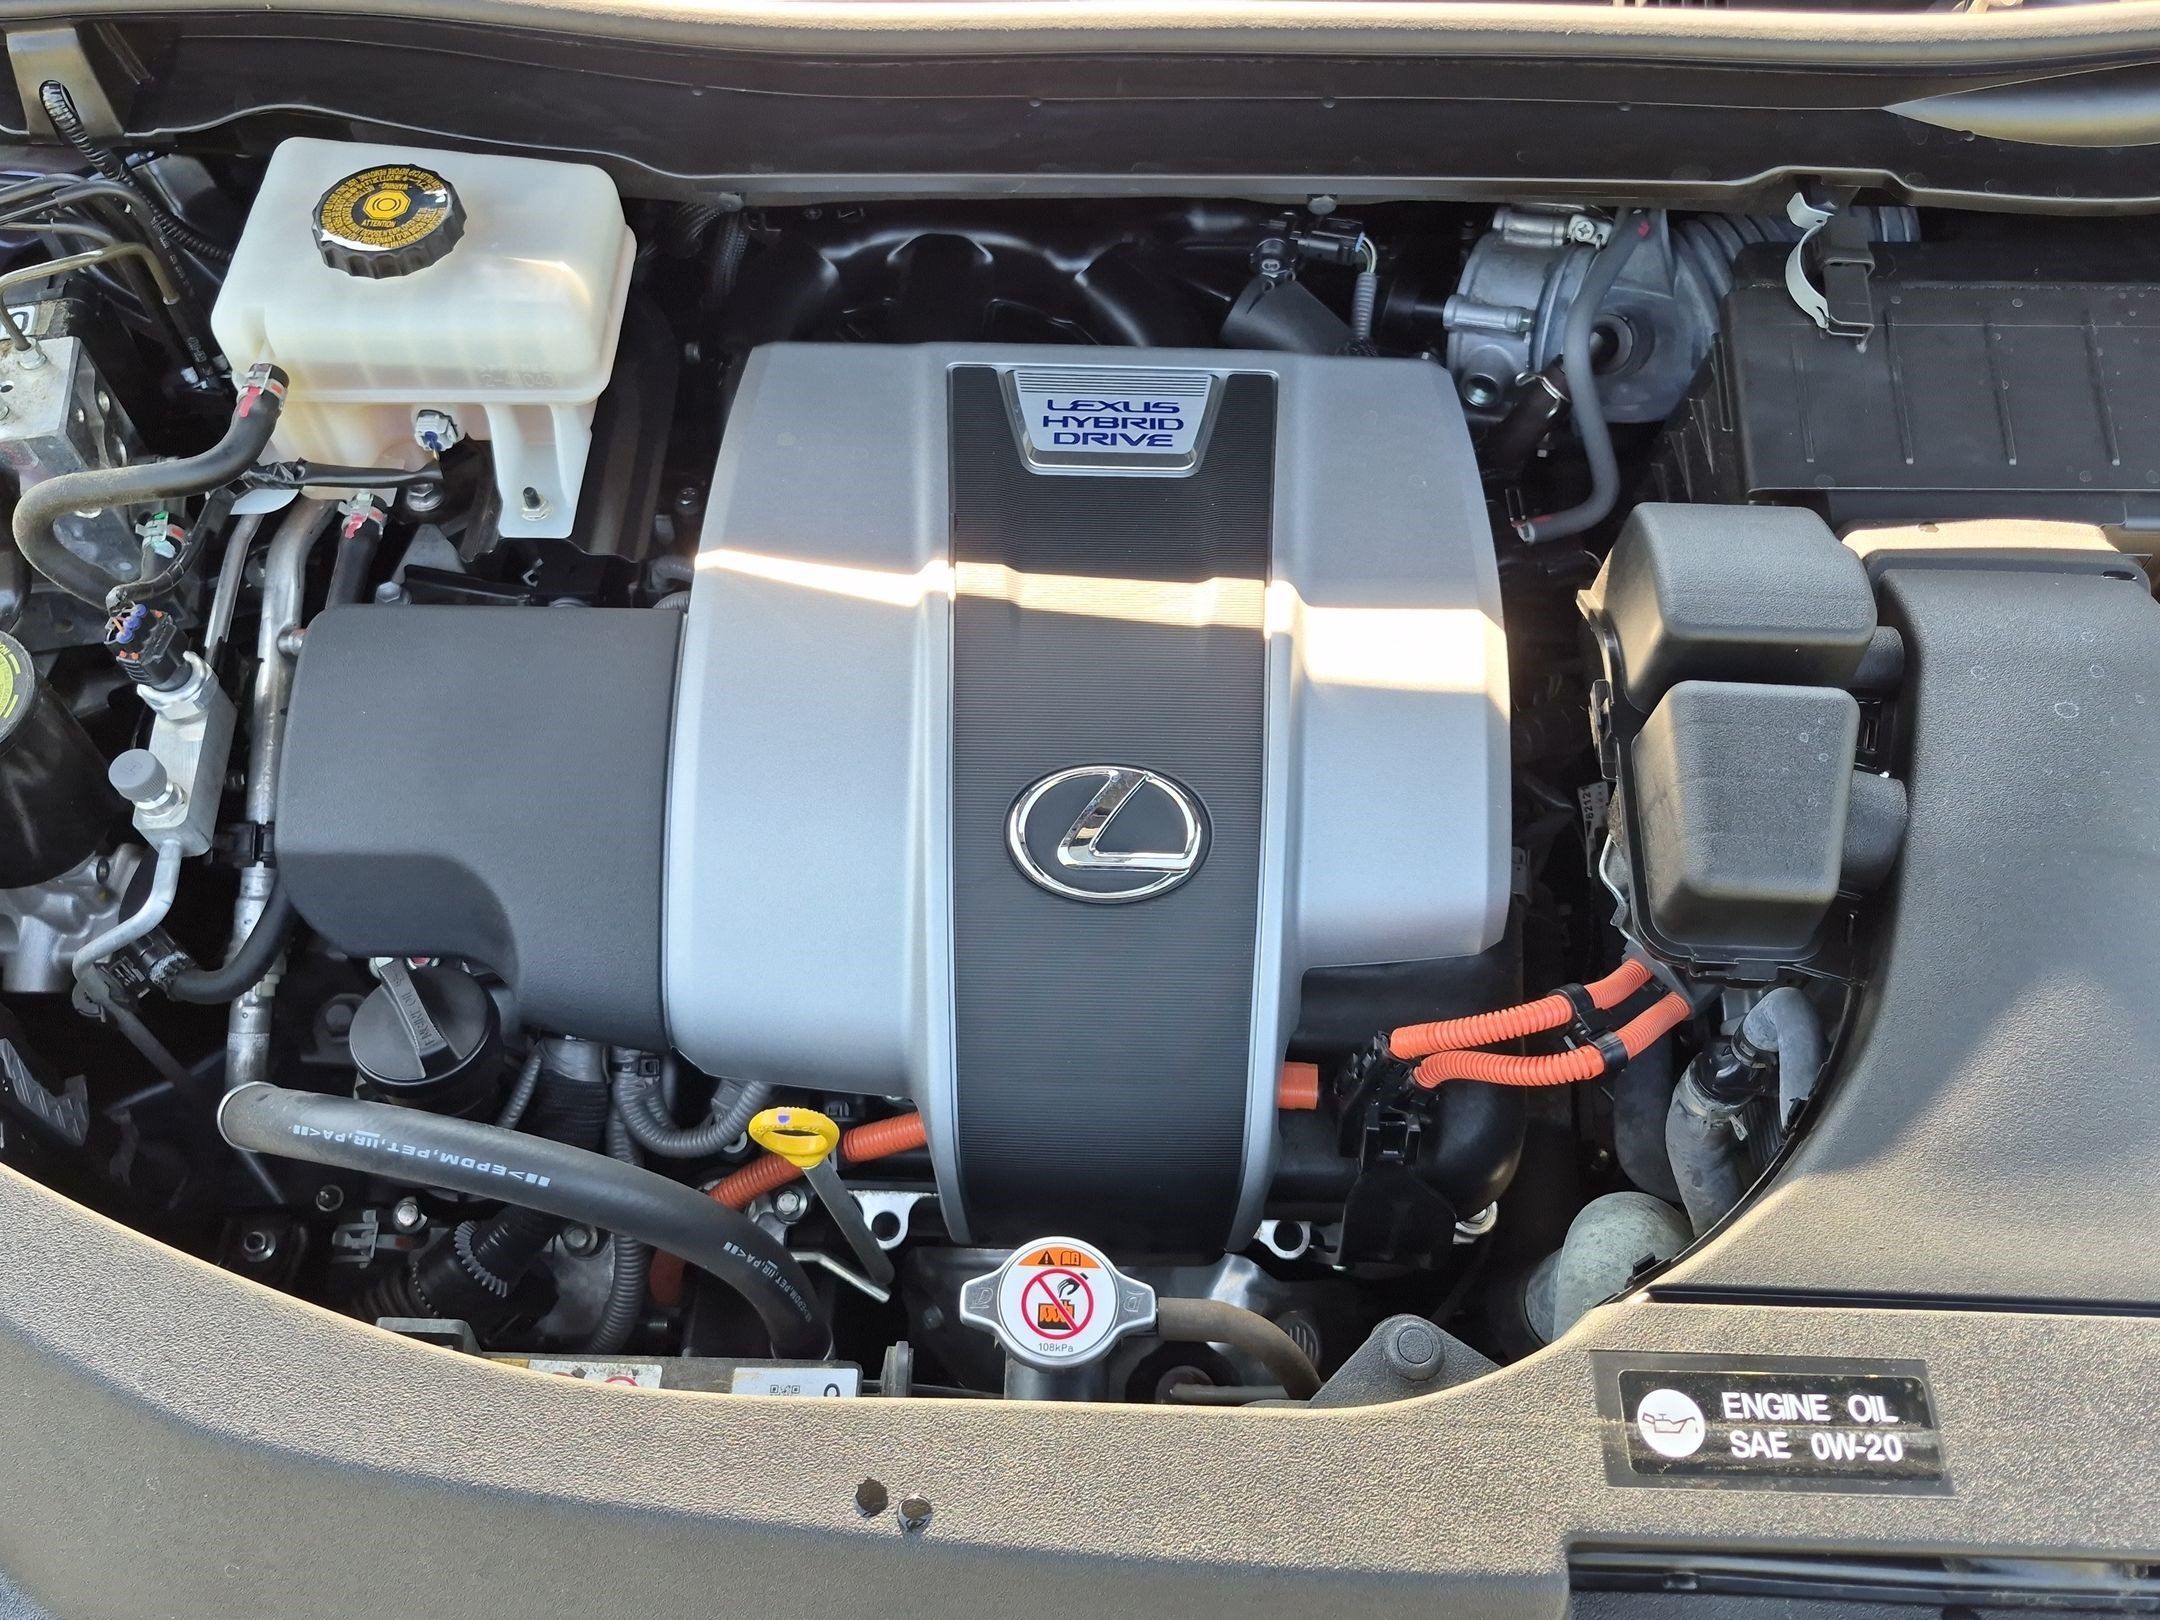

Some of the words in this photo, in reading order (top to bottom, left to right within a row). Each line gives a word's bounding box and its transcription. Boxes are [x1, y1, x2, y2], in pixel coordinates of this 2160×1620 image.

[361, 219, 396, 228] ATTENTION
[1047, 399, 1180, 414] LEXUS
[1043, 415, 1184, 431] HYBRID
[1053, 432, 1173, 447] DRIVE
[1038, 1342, 1074, 1353] 108kPa
[1721, 1391, 1831, 1422] ENGINE
[1847, 1394, 1899, 1423] OIL
[1729, 1429, 1792, 1459] SAE
[1810, 1431, 1904, 1462] 0W-20
